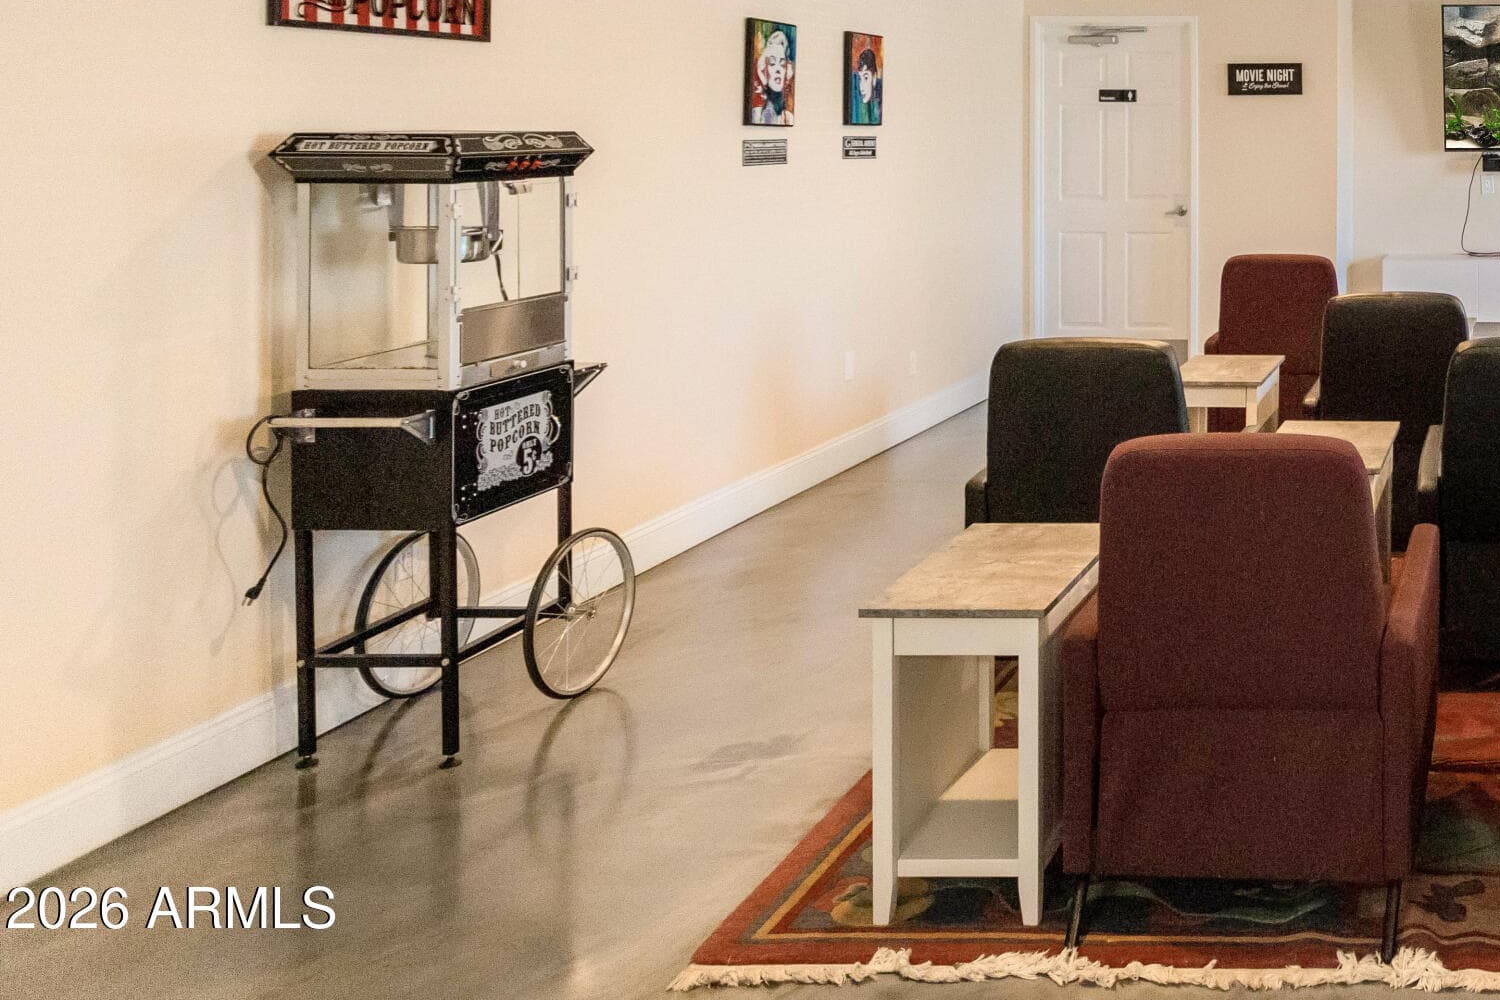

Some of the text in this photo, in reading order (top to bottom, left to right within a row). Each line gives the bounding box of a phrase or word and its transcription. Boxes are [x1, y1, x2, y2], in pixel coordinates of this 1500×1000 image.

[1235, 68, 1295, 82] MOVIE NIGHT
[383, 142, 430, 151] POPCORN
[489, 403, 541, 435] BUTTERED
[494, 405, 511, 420] HOT
[489, 421, 541, 452] POPCORN
